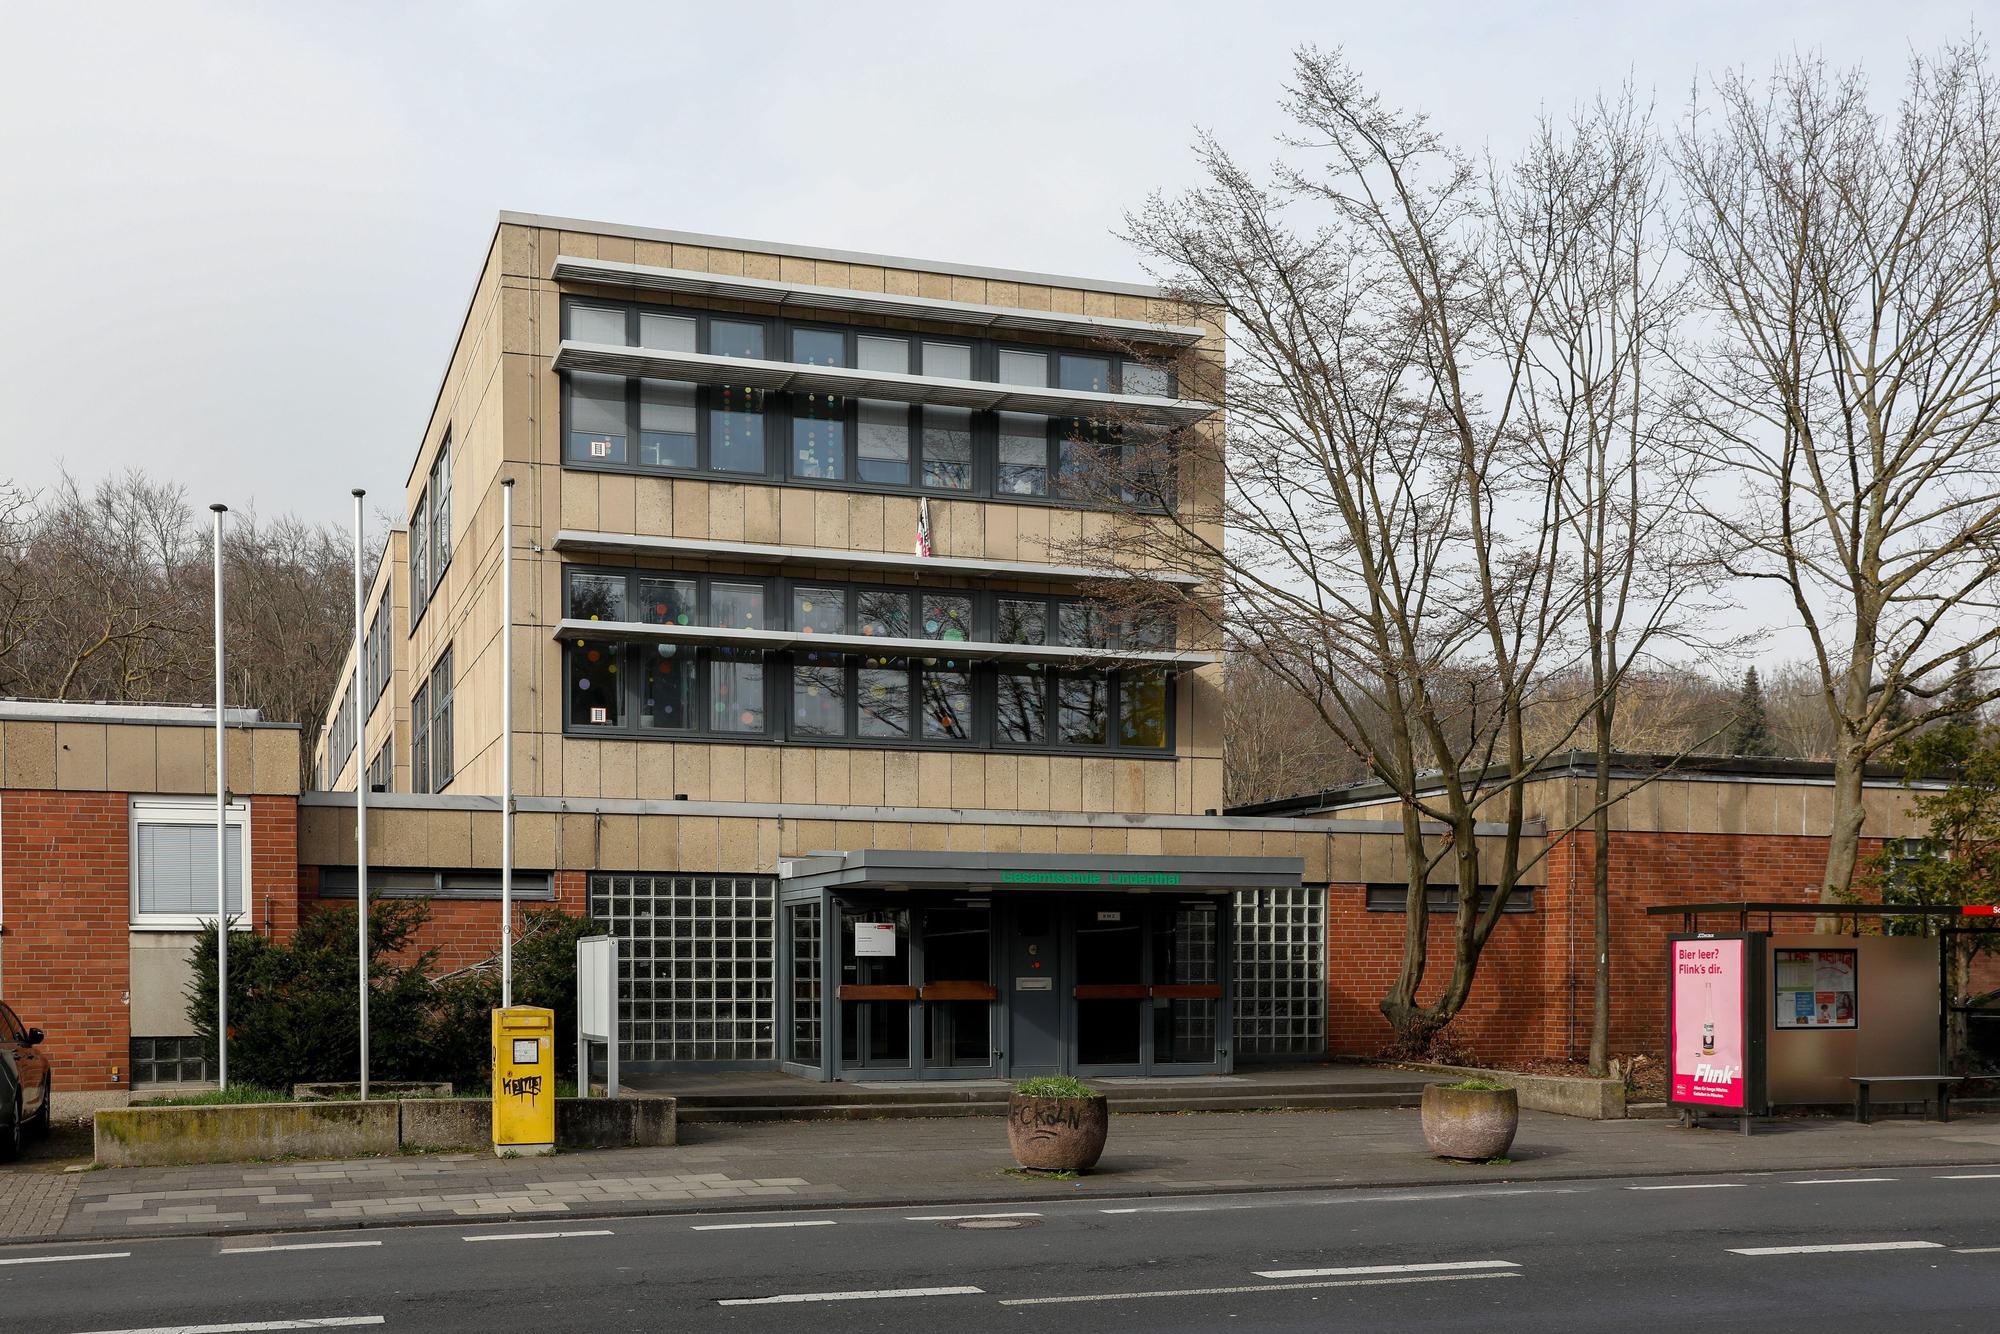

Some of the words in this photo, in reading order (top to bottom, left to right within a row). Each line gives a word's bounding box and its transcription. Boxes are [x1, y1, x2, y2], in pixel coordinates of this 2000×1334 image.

[1001, 871, 1101, 884] Gesamtschule
[1109, 871, 1181, 885] Lindenthal
[1679, 949, 1696, 960] Bier
[1698, 948, 1720, 959] leer?
[1707, 963, 1723, 974] dir.
[1694, 1064, 1733, 1084] Flink
